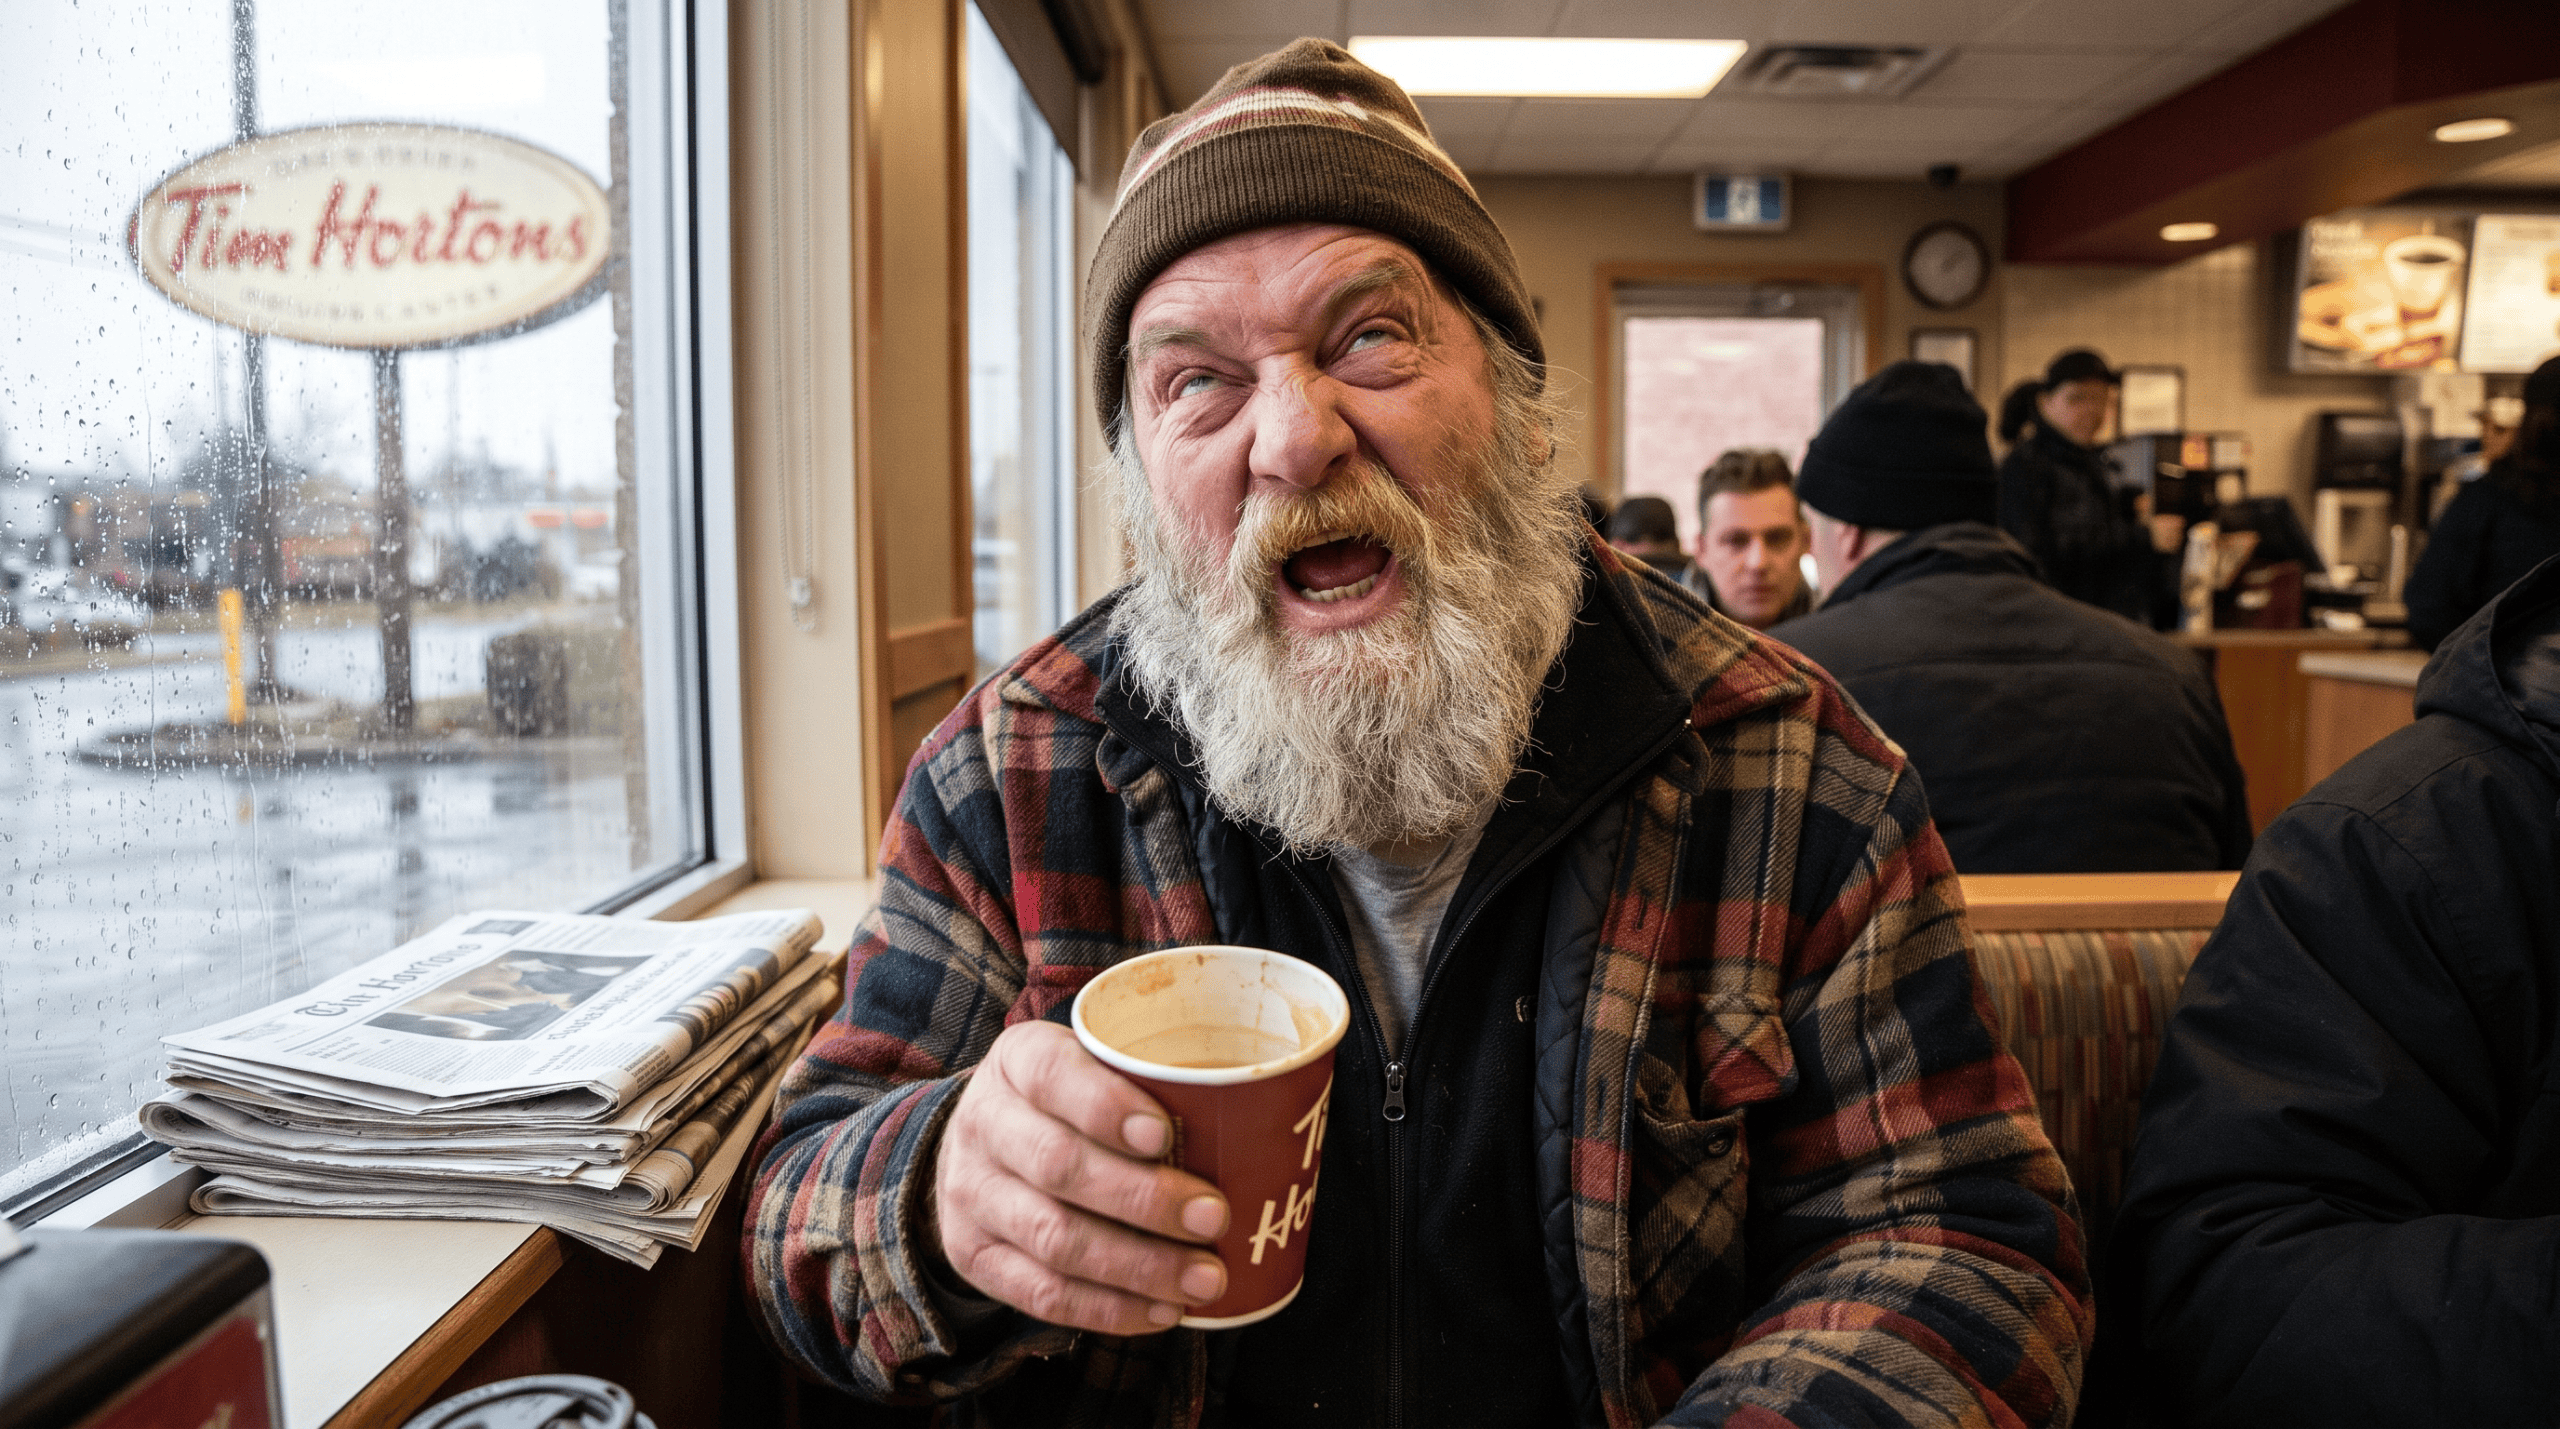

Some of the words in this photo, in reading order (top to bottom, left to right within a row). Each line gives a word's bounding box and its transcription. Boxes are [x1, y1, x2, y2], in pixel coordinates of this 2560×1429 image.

[164, 182, 293, 273] Tim
[309, 179, 588, 270] Hortons
[1249, 1166, 1320, 1264] Ho
